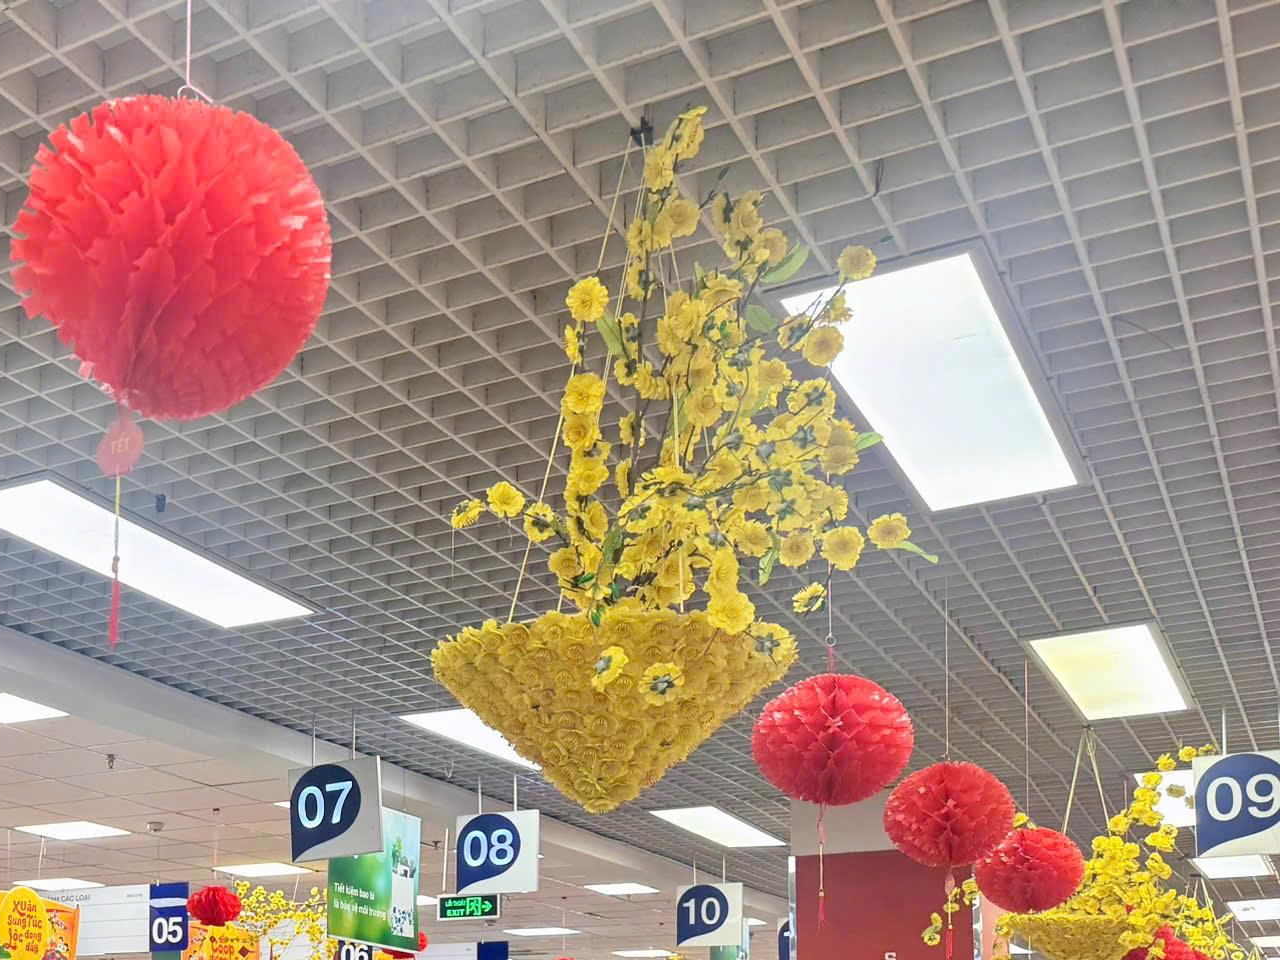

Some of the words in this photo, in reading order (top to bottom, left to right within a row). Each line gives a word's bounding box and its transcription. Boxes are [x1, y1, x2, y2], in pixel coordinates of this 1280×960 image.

[297, 780, 353, 829] 07
[1206, 771, 1280, 821] 09
[463, 829, 515, 867] 08
[334, 881, 345, 894] Tiết
[8, 914, 26, 929] Sung
[446, 908, 465, 917] EXIT
[683, 897, 721, 925] 10
[152, 916, 183, 944] 05
